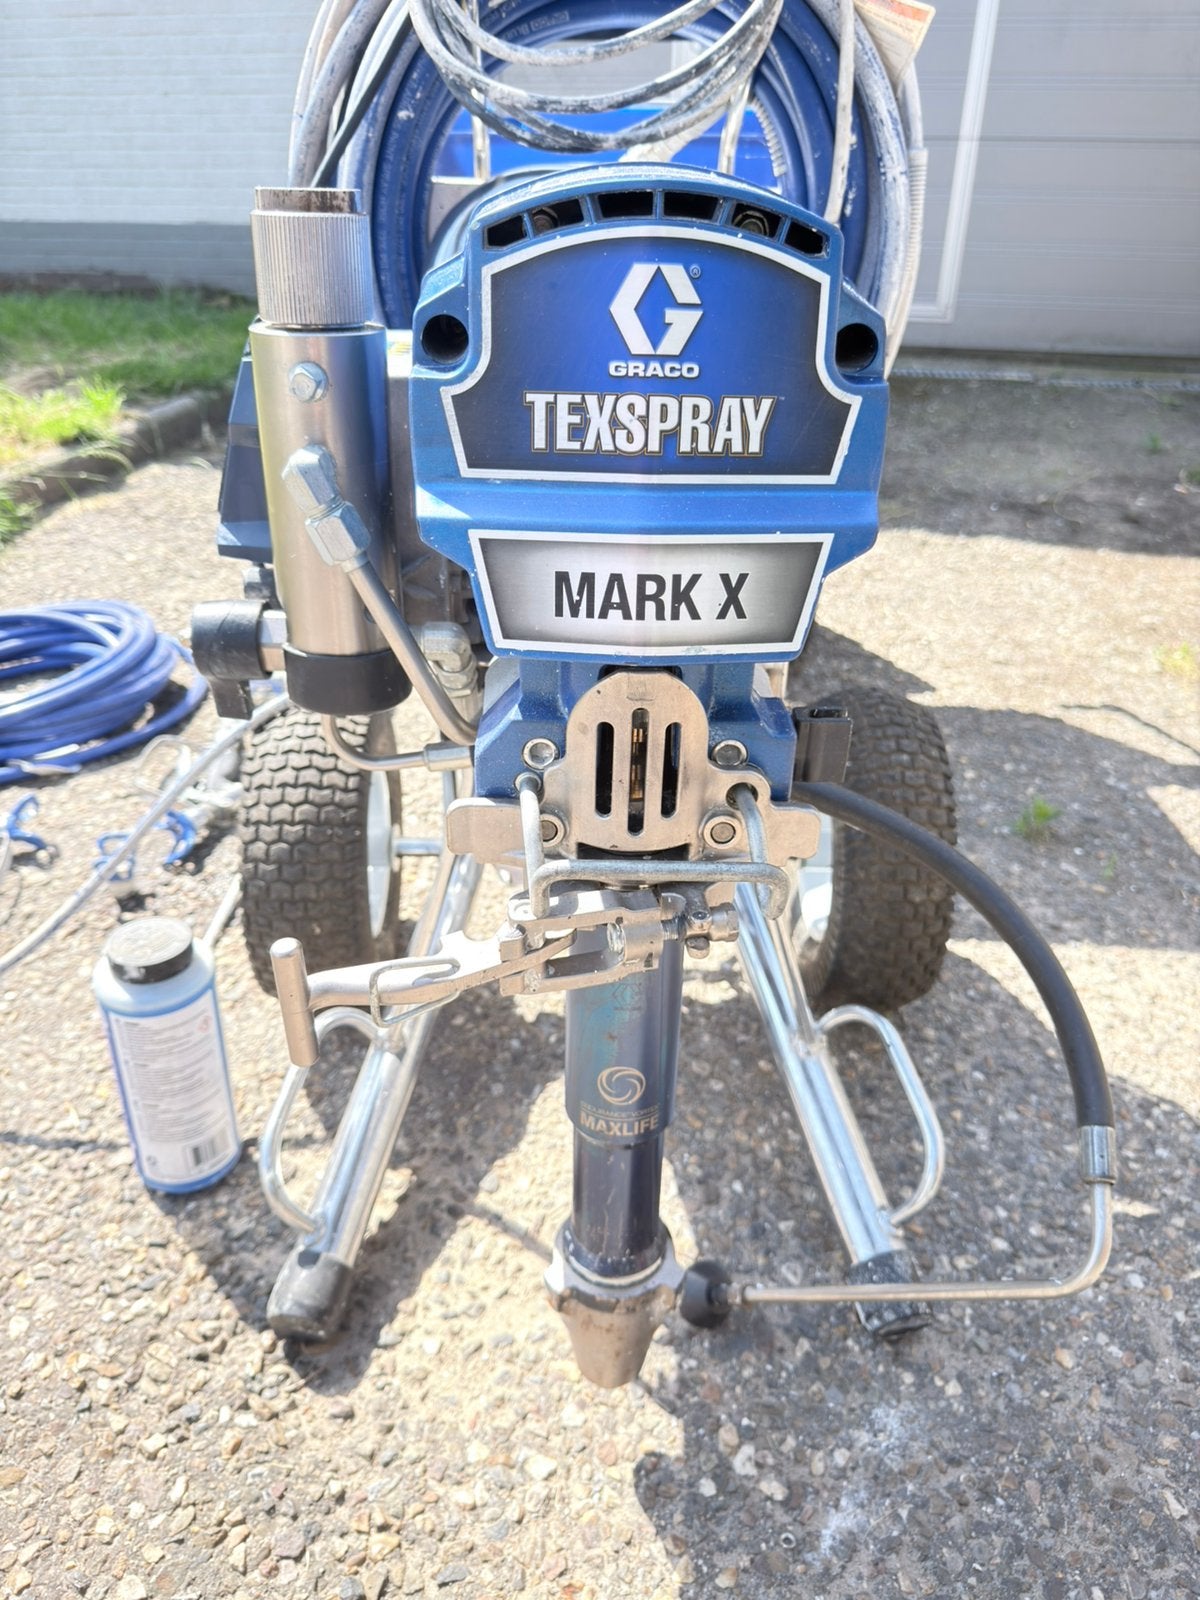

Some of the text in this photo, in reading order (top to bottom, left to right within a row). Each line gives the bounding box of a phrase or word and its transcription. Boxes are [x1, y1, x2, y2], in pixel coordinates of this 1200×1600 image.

[608, 360, 700, 379] GRACO
[524, 391, 777, 457] TEXSPRAY
[554, 570, 750, 621] MARK X
[579, 1110, 660, 1136] MAXLIFE
